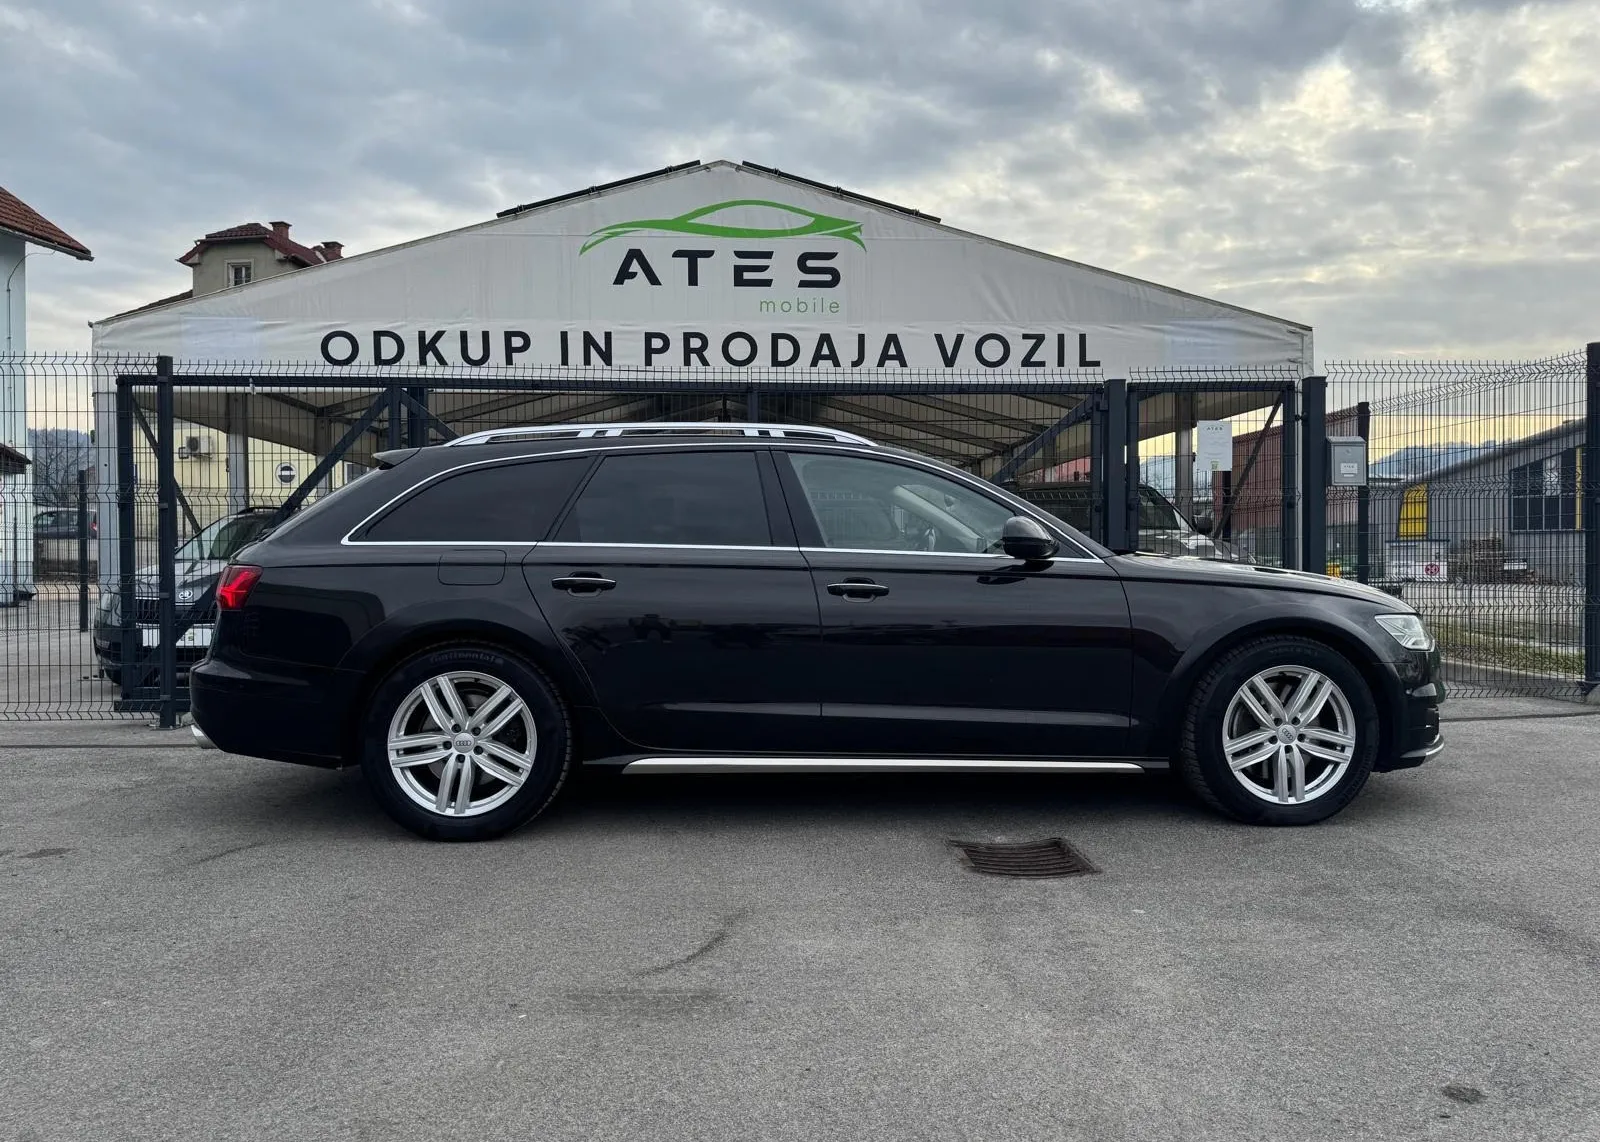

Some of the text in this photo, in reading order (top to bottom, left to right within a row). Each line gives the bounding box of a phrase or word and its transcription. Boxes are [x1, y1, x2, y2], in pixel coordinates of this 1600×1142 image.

[613, 248, 841, 289] ATES
[759, 297, 841, 314] mobile
[320, 330, 1101, 368] ODKUP IN PRODAJA VOZIL
